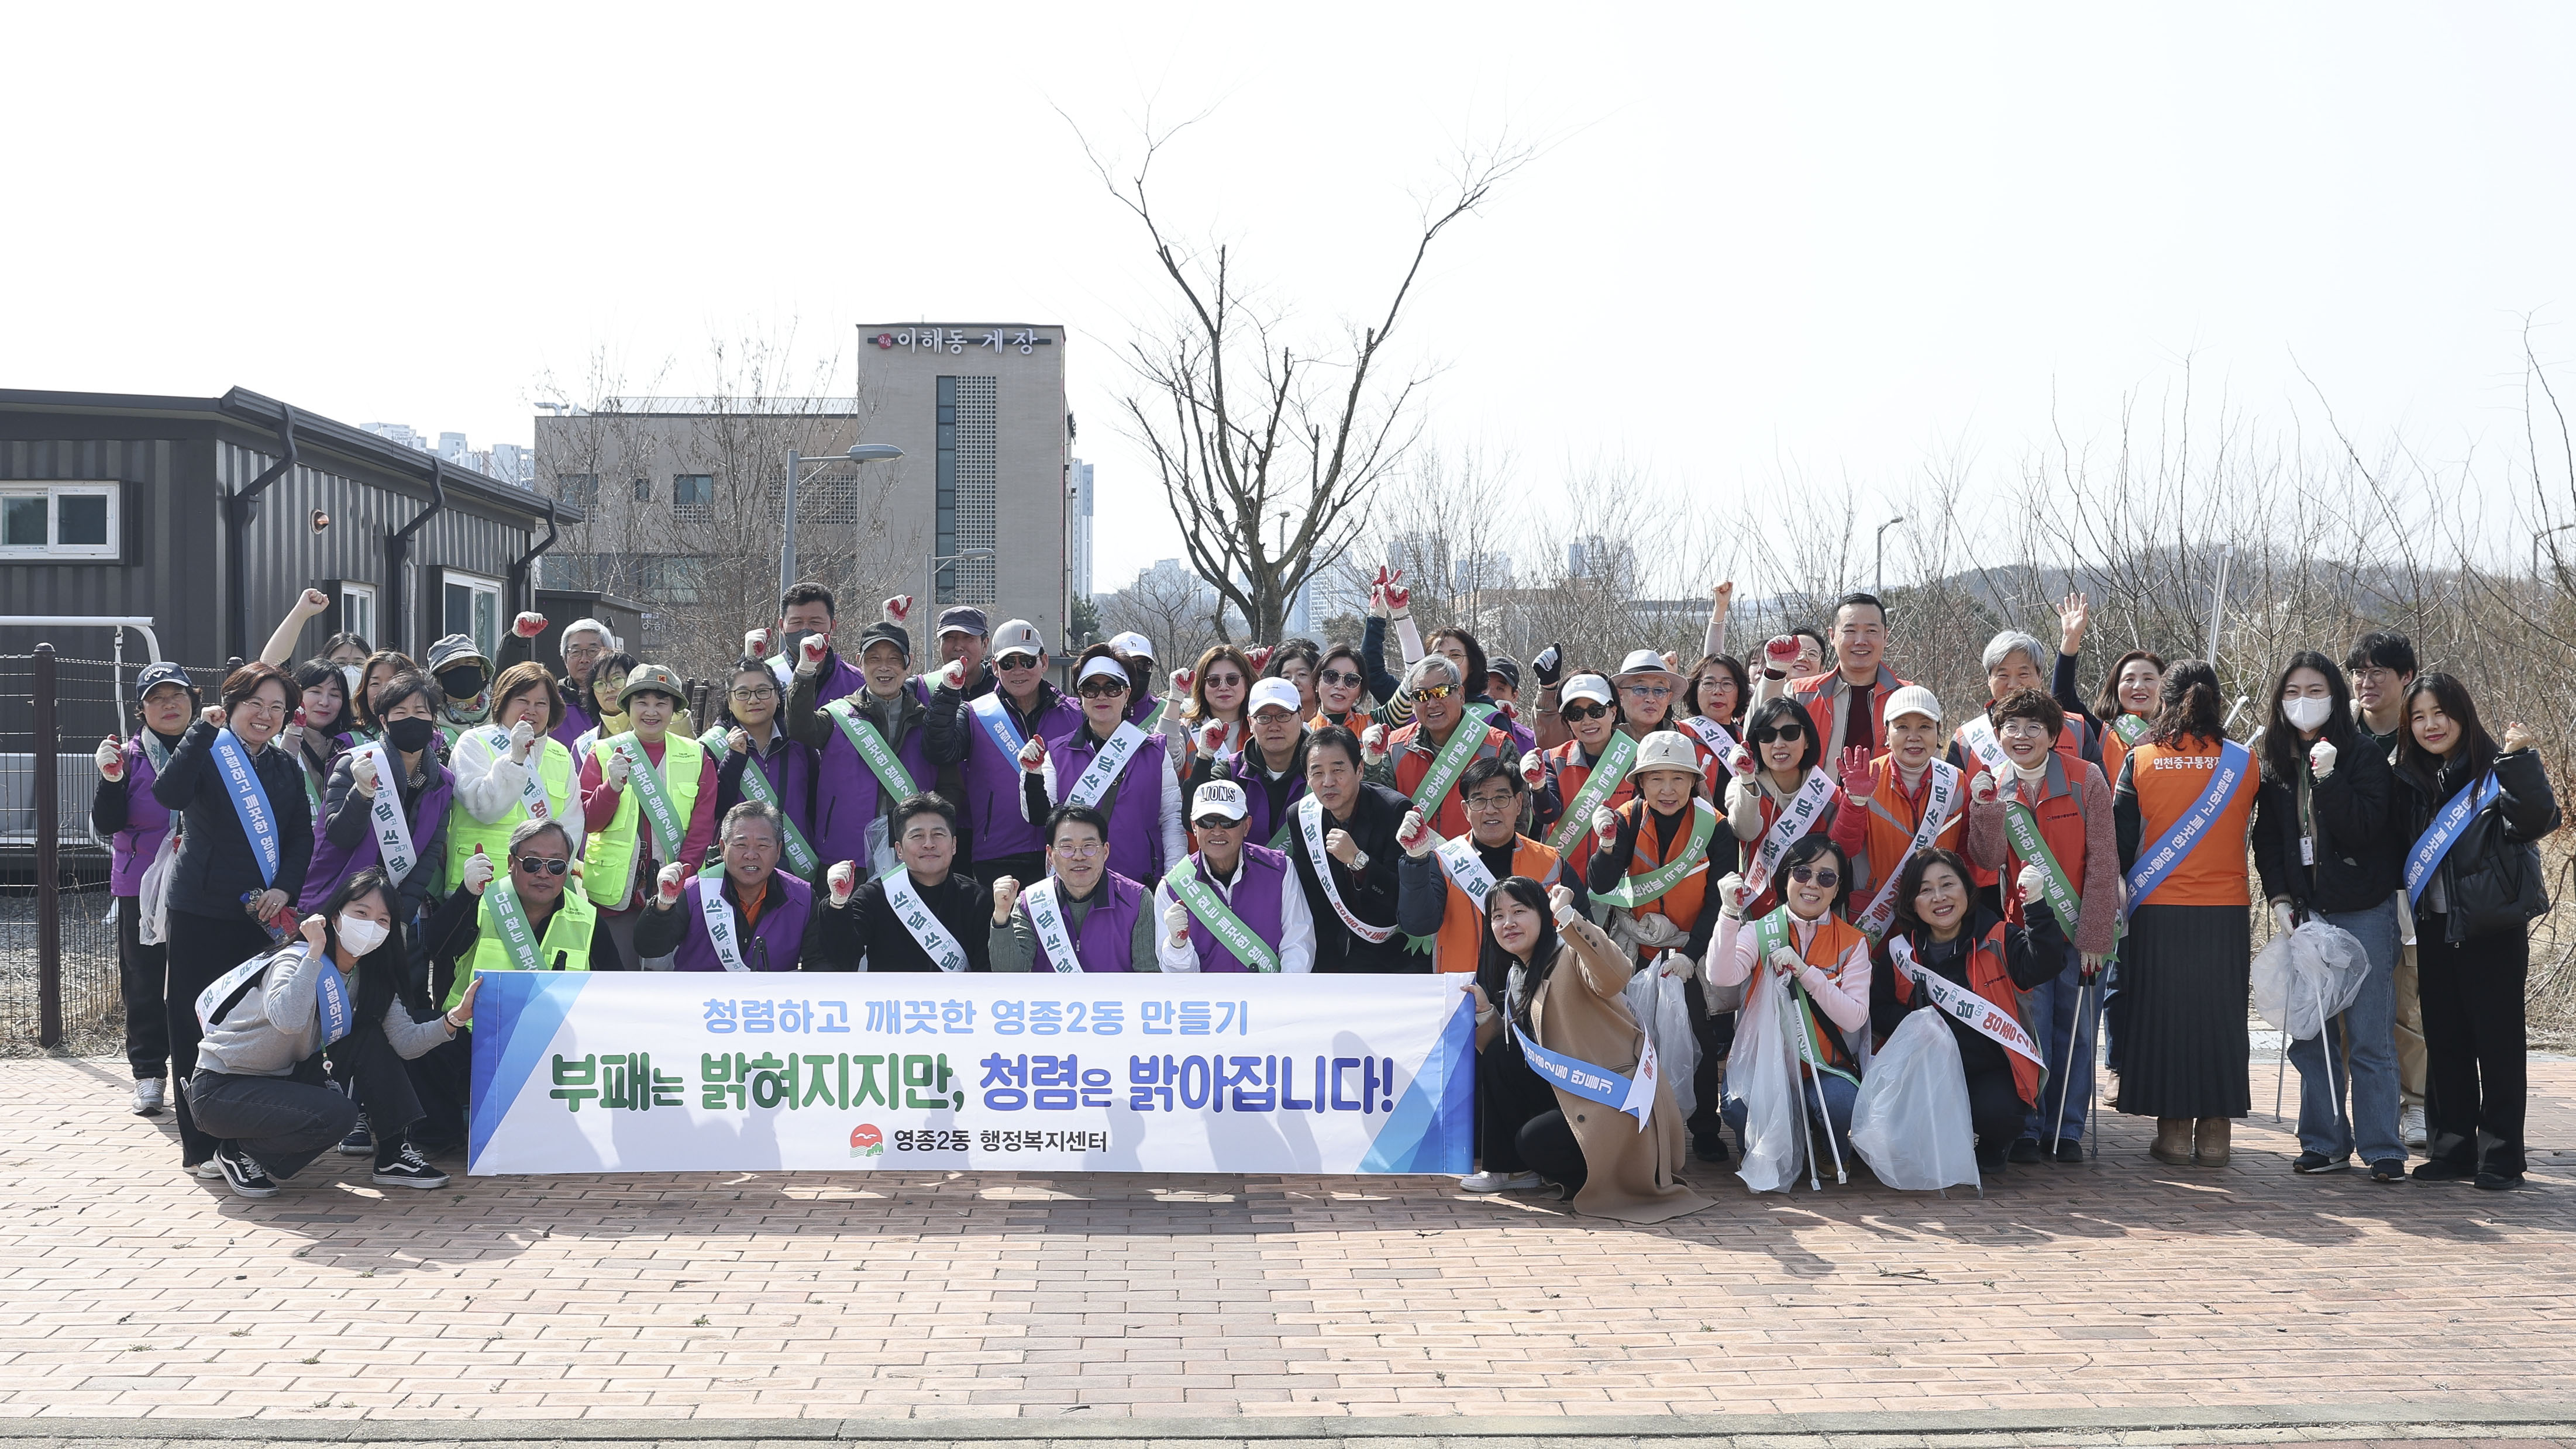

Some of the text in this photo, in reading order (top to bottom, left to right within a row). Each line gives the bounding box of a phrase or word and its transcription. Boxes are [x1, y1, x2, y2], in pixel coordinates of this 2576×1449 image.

[897, 327, 968, 355] 이해동
[144, 667, 173, 681] Callaway
[861, 734, 889, 767] 깨끗한
[884, 765, 914, 796] 영종2
[1447, 741, 1468, 766] 찾는
[1201, 786, 1235, 802] LIONS
[1425, 764, 1453, 799] 깨끗한
[1598, 763, 1617, 789] 찾는
[2200, 767, 2236, 816] 청렴하고
[219, 744, 278, 880] 청렴하고 깨끗한 영종2
[631, 762, 656, 795] 깨끗한
[649, 795, 679, 841] 영종2동
[1575, 786, 1604, 823] 깨끗한
[1554, 821, 1580, 853] 영종2
[2171, 814, 2206, 850] 깨끗한
[2419, 827, 2448, 864] 깨끗한
[1664, 861, 1688, 882] 찾는
[1743, 861, 1766, 896] 영종2
[2008, 813, 2036, 851] 깨끗한
[2029, 851, 2065, 899] 영종2동
[2058, 899, 2079, 932] 만들
[2134, 846, 2175, 888] 영종2동
[2406, 861, 2425, 892] 영종2
[1634, 878, 1665, 898] 깨끗한
[1196, 895, 1220, 919] 찾는
[1215, 916, 1251, 949] 깨끗한
[1334, 901, 1388, 941] 영종2동
[504, 916, 525, 943] 찾는
[516, 944, 538, 971] 깨끗
[323, 975, 343, 1027] 청렴하고
[704, 999, 1247, 1036] 청렴하고 깨끗한 영종2동 만들기
[551, 1052, 1394, 1113] 부패는 밝혀지지만, 청렴은 밝아집니다!
[1527, 1047, 1613, 1095] 영종2동 만들기
[894, 1130, 1107, 1153] 영종2동 행정복지센터
